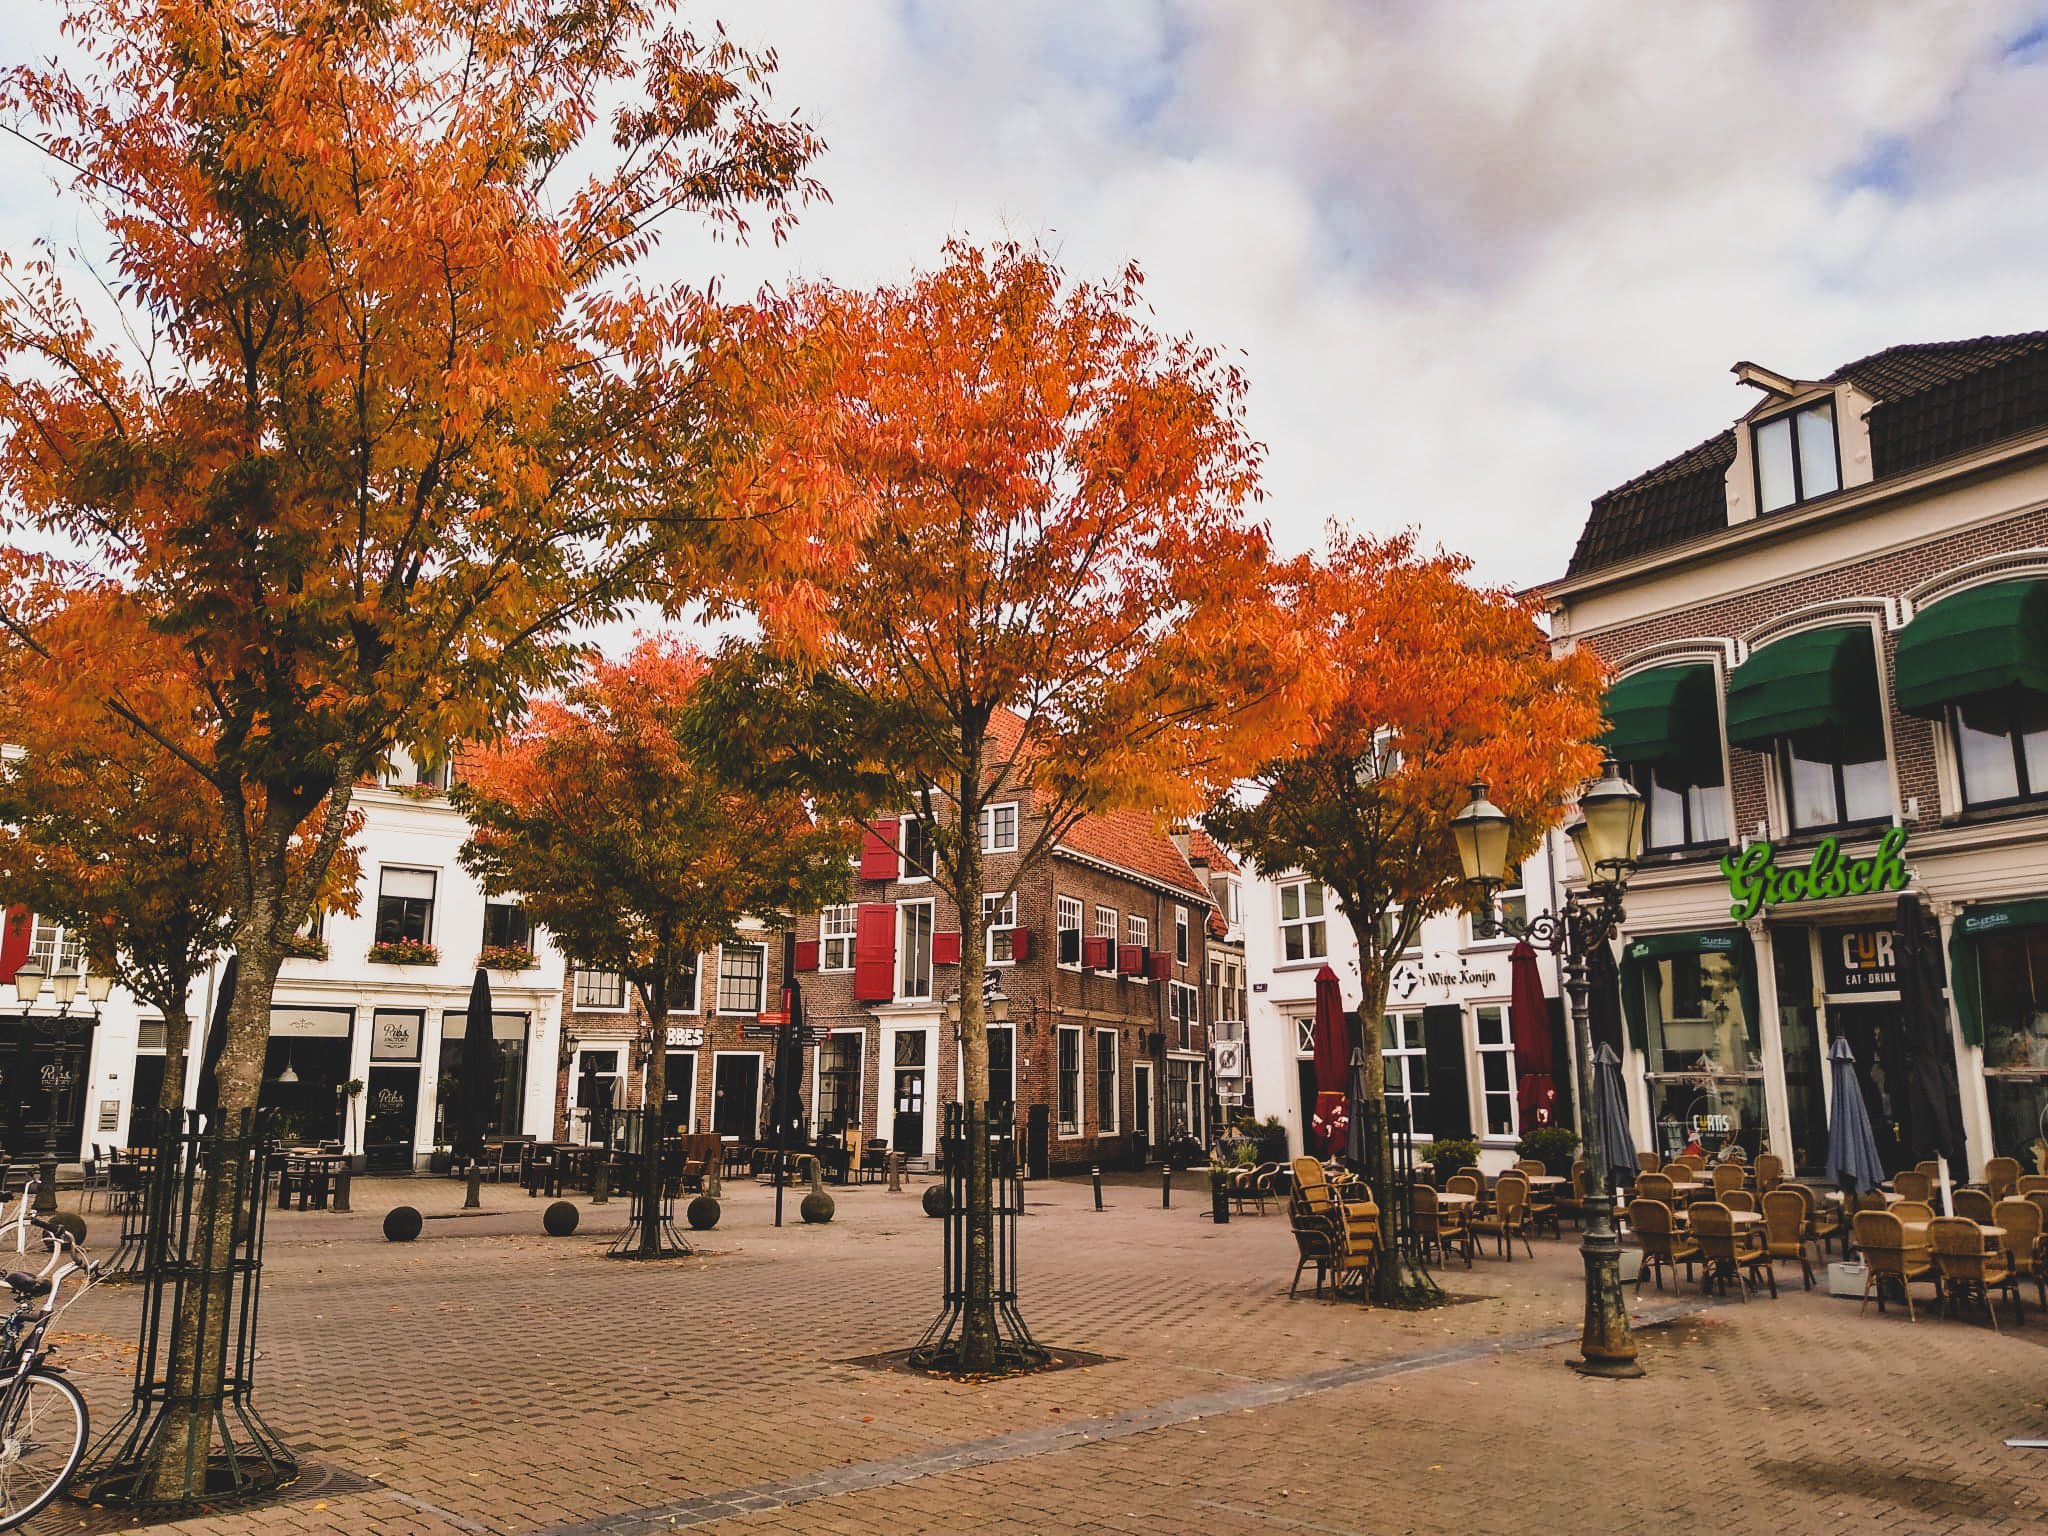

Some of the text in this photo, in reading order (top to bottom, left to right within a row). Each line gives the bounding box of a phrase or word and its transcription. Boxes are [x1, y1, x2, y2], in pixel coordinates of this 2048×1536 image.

[1720, 827, 1911, 920] Grolsch
[1842, 929, 1904, 969] CUR
[1459, 969, 1496, 988] Konijn
[1846, 972, 1896, 985] EAT DRINK
[650, 1027, 703, 1046] BBES
[1693, 1114, 1730, 1132] CURTIS
